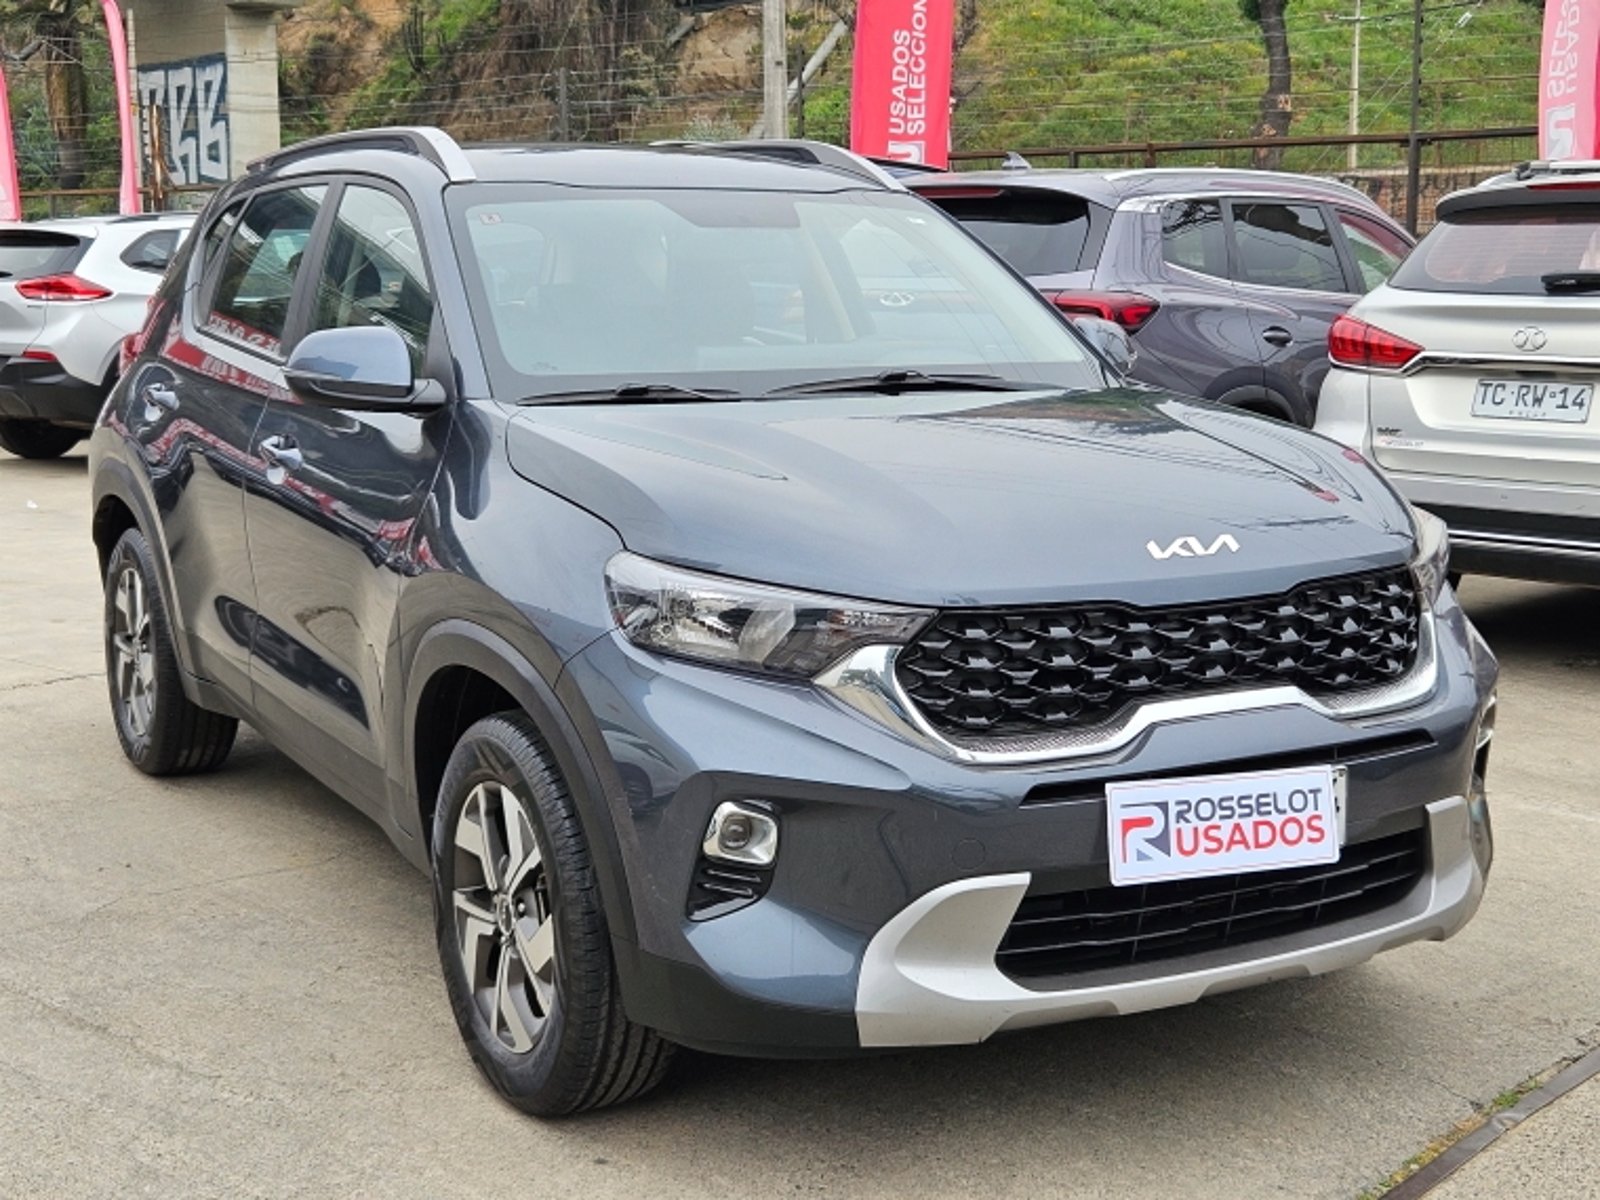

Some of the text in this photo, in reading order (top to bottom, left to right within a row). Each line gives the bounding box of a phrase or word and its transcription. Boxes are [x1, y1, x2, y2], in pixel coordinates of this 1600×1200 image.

[888, 30, 911, 134] USADOS
[1146, 533, 1241, 560] KIA
[1175, 788, 1322, 824] ROSSELOT
[1176, 814, 1326, 857] USADOS
